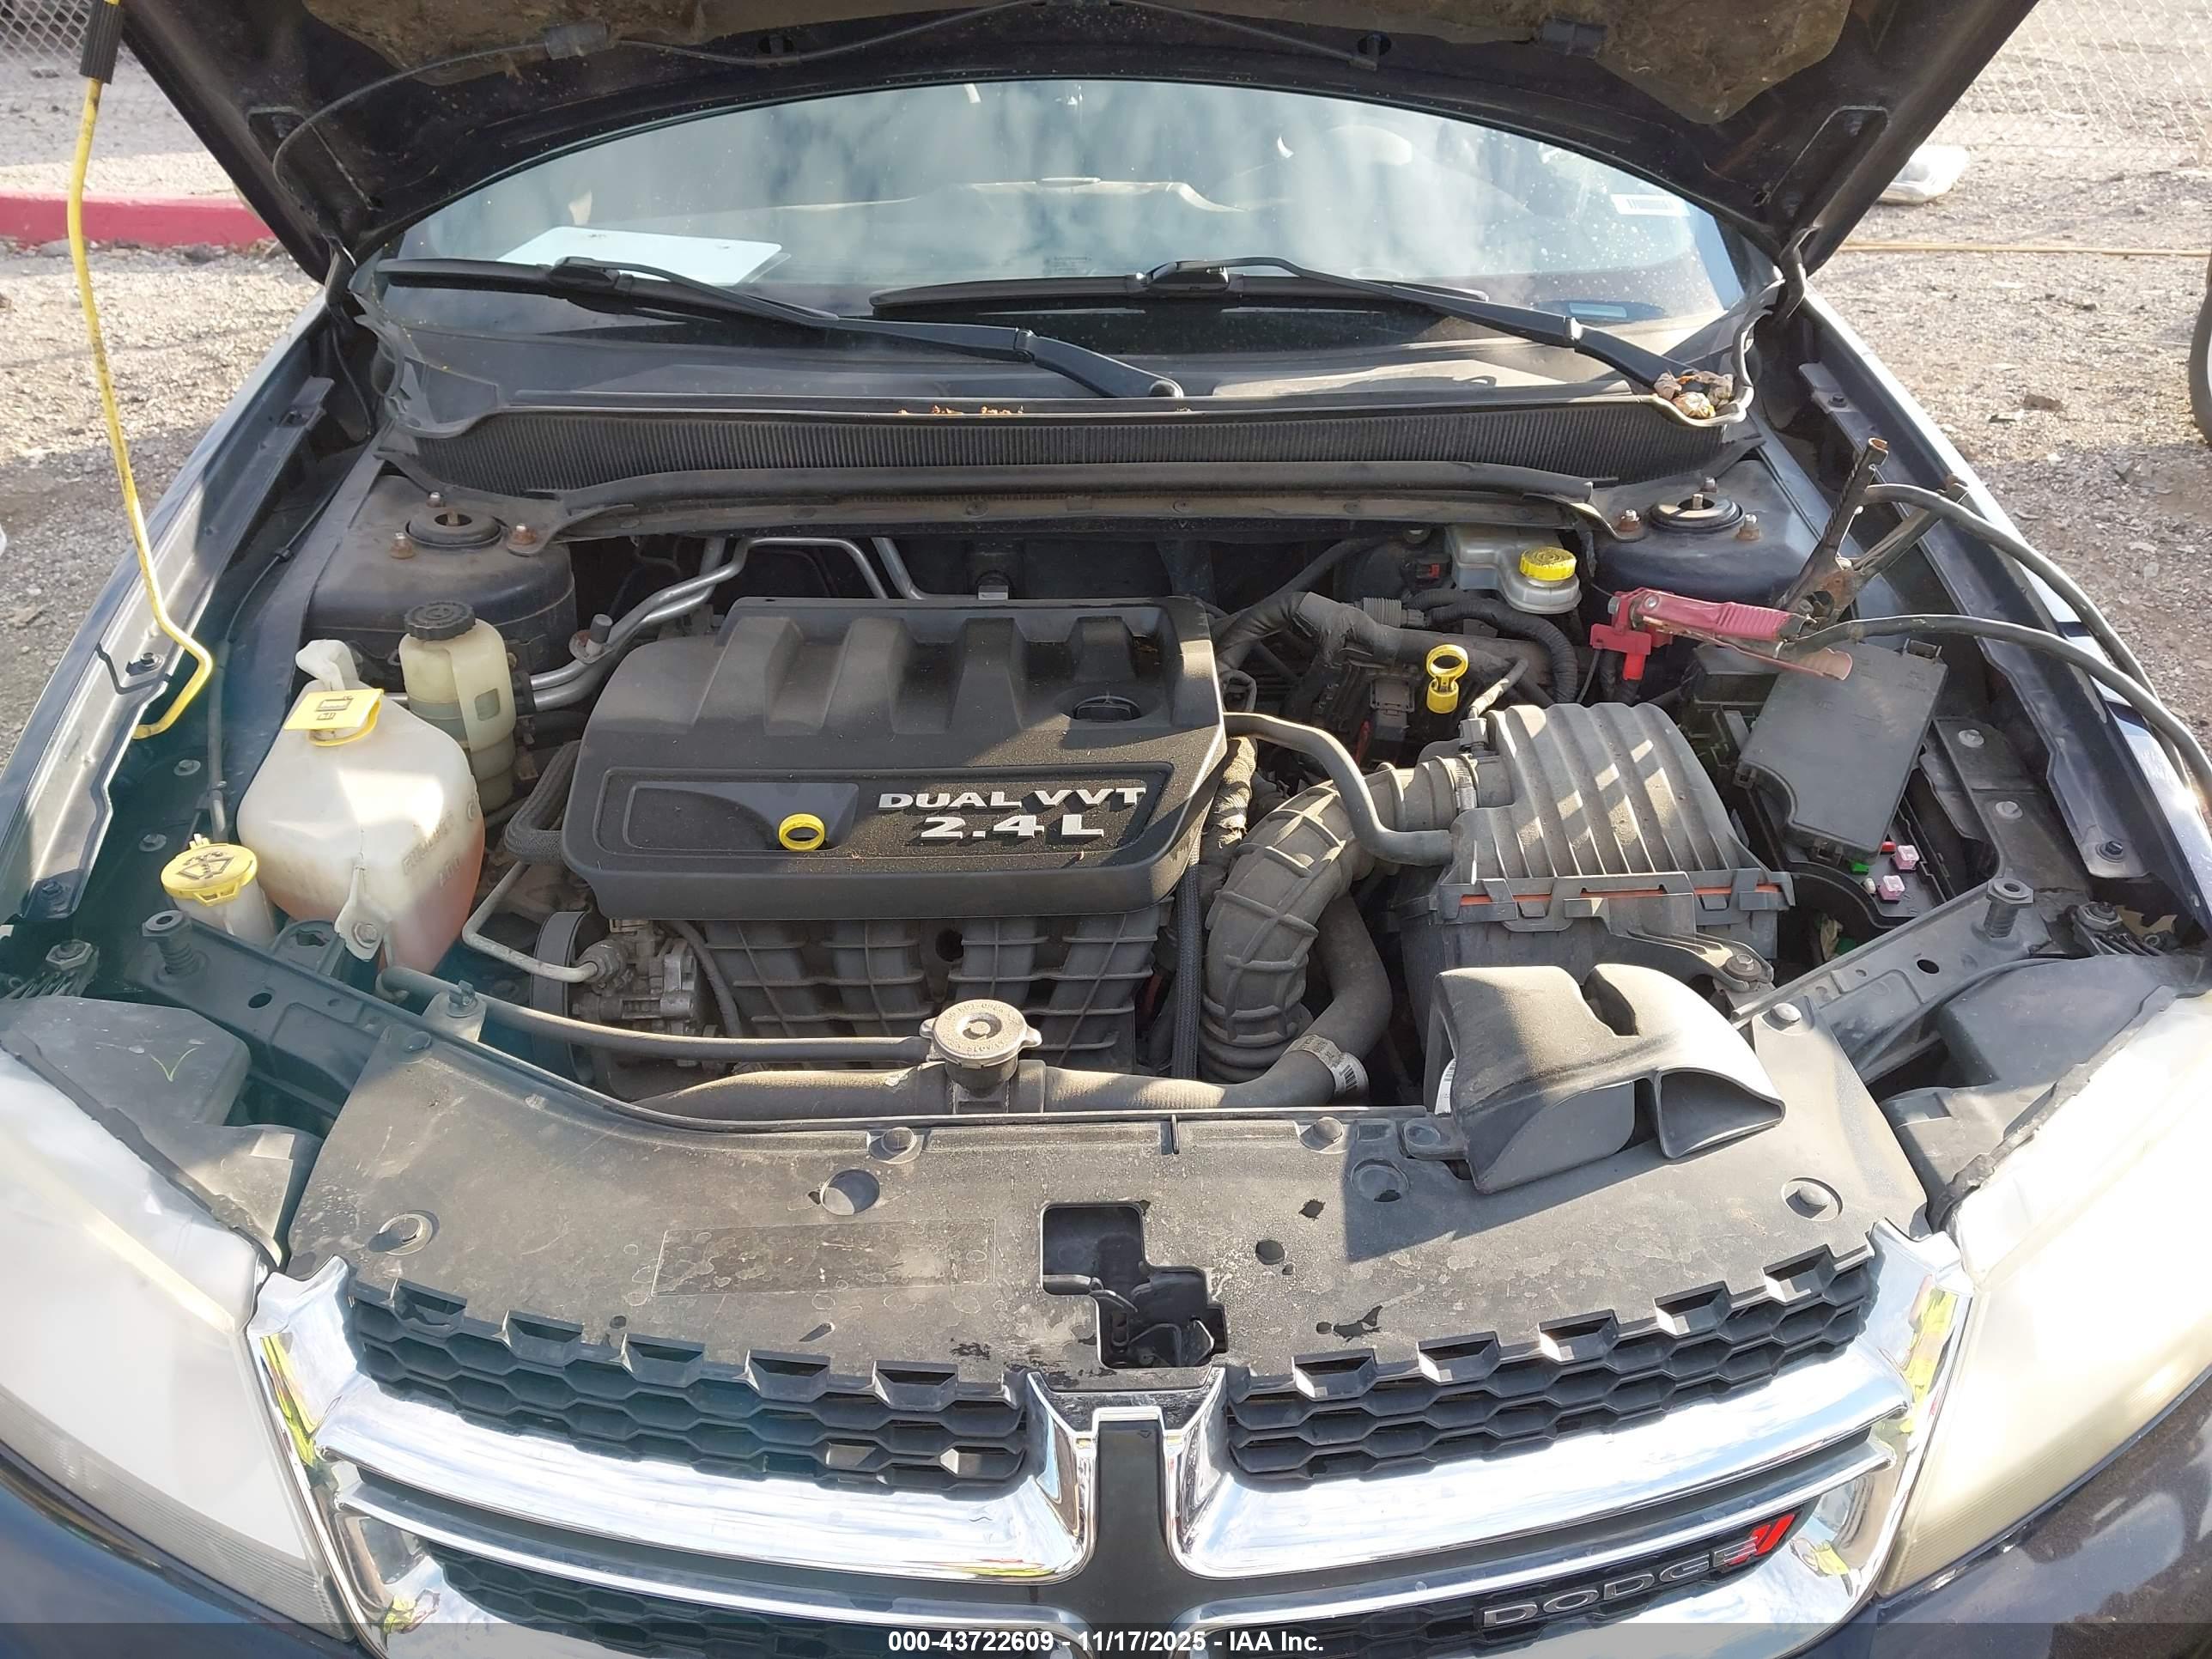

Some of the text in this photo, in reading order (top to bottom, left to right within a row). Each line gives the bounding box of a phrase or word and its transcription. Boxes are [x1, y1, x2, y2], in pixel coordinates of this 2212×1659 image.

[878, 787, 1146, 810] DUAL VVT
[921, 814, 1104, 839] 2.4 L
[1484, 1536, 1758, 1627] DODGE
